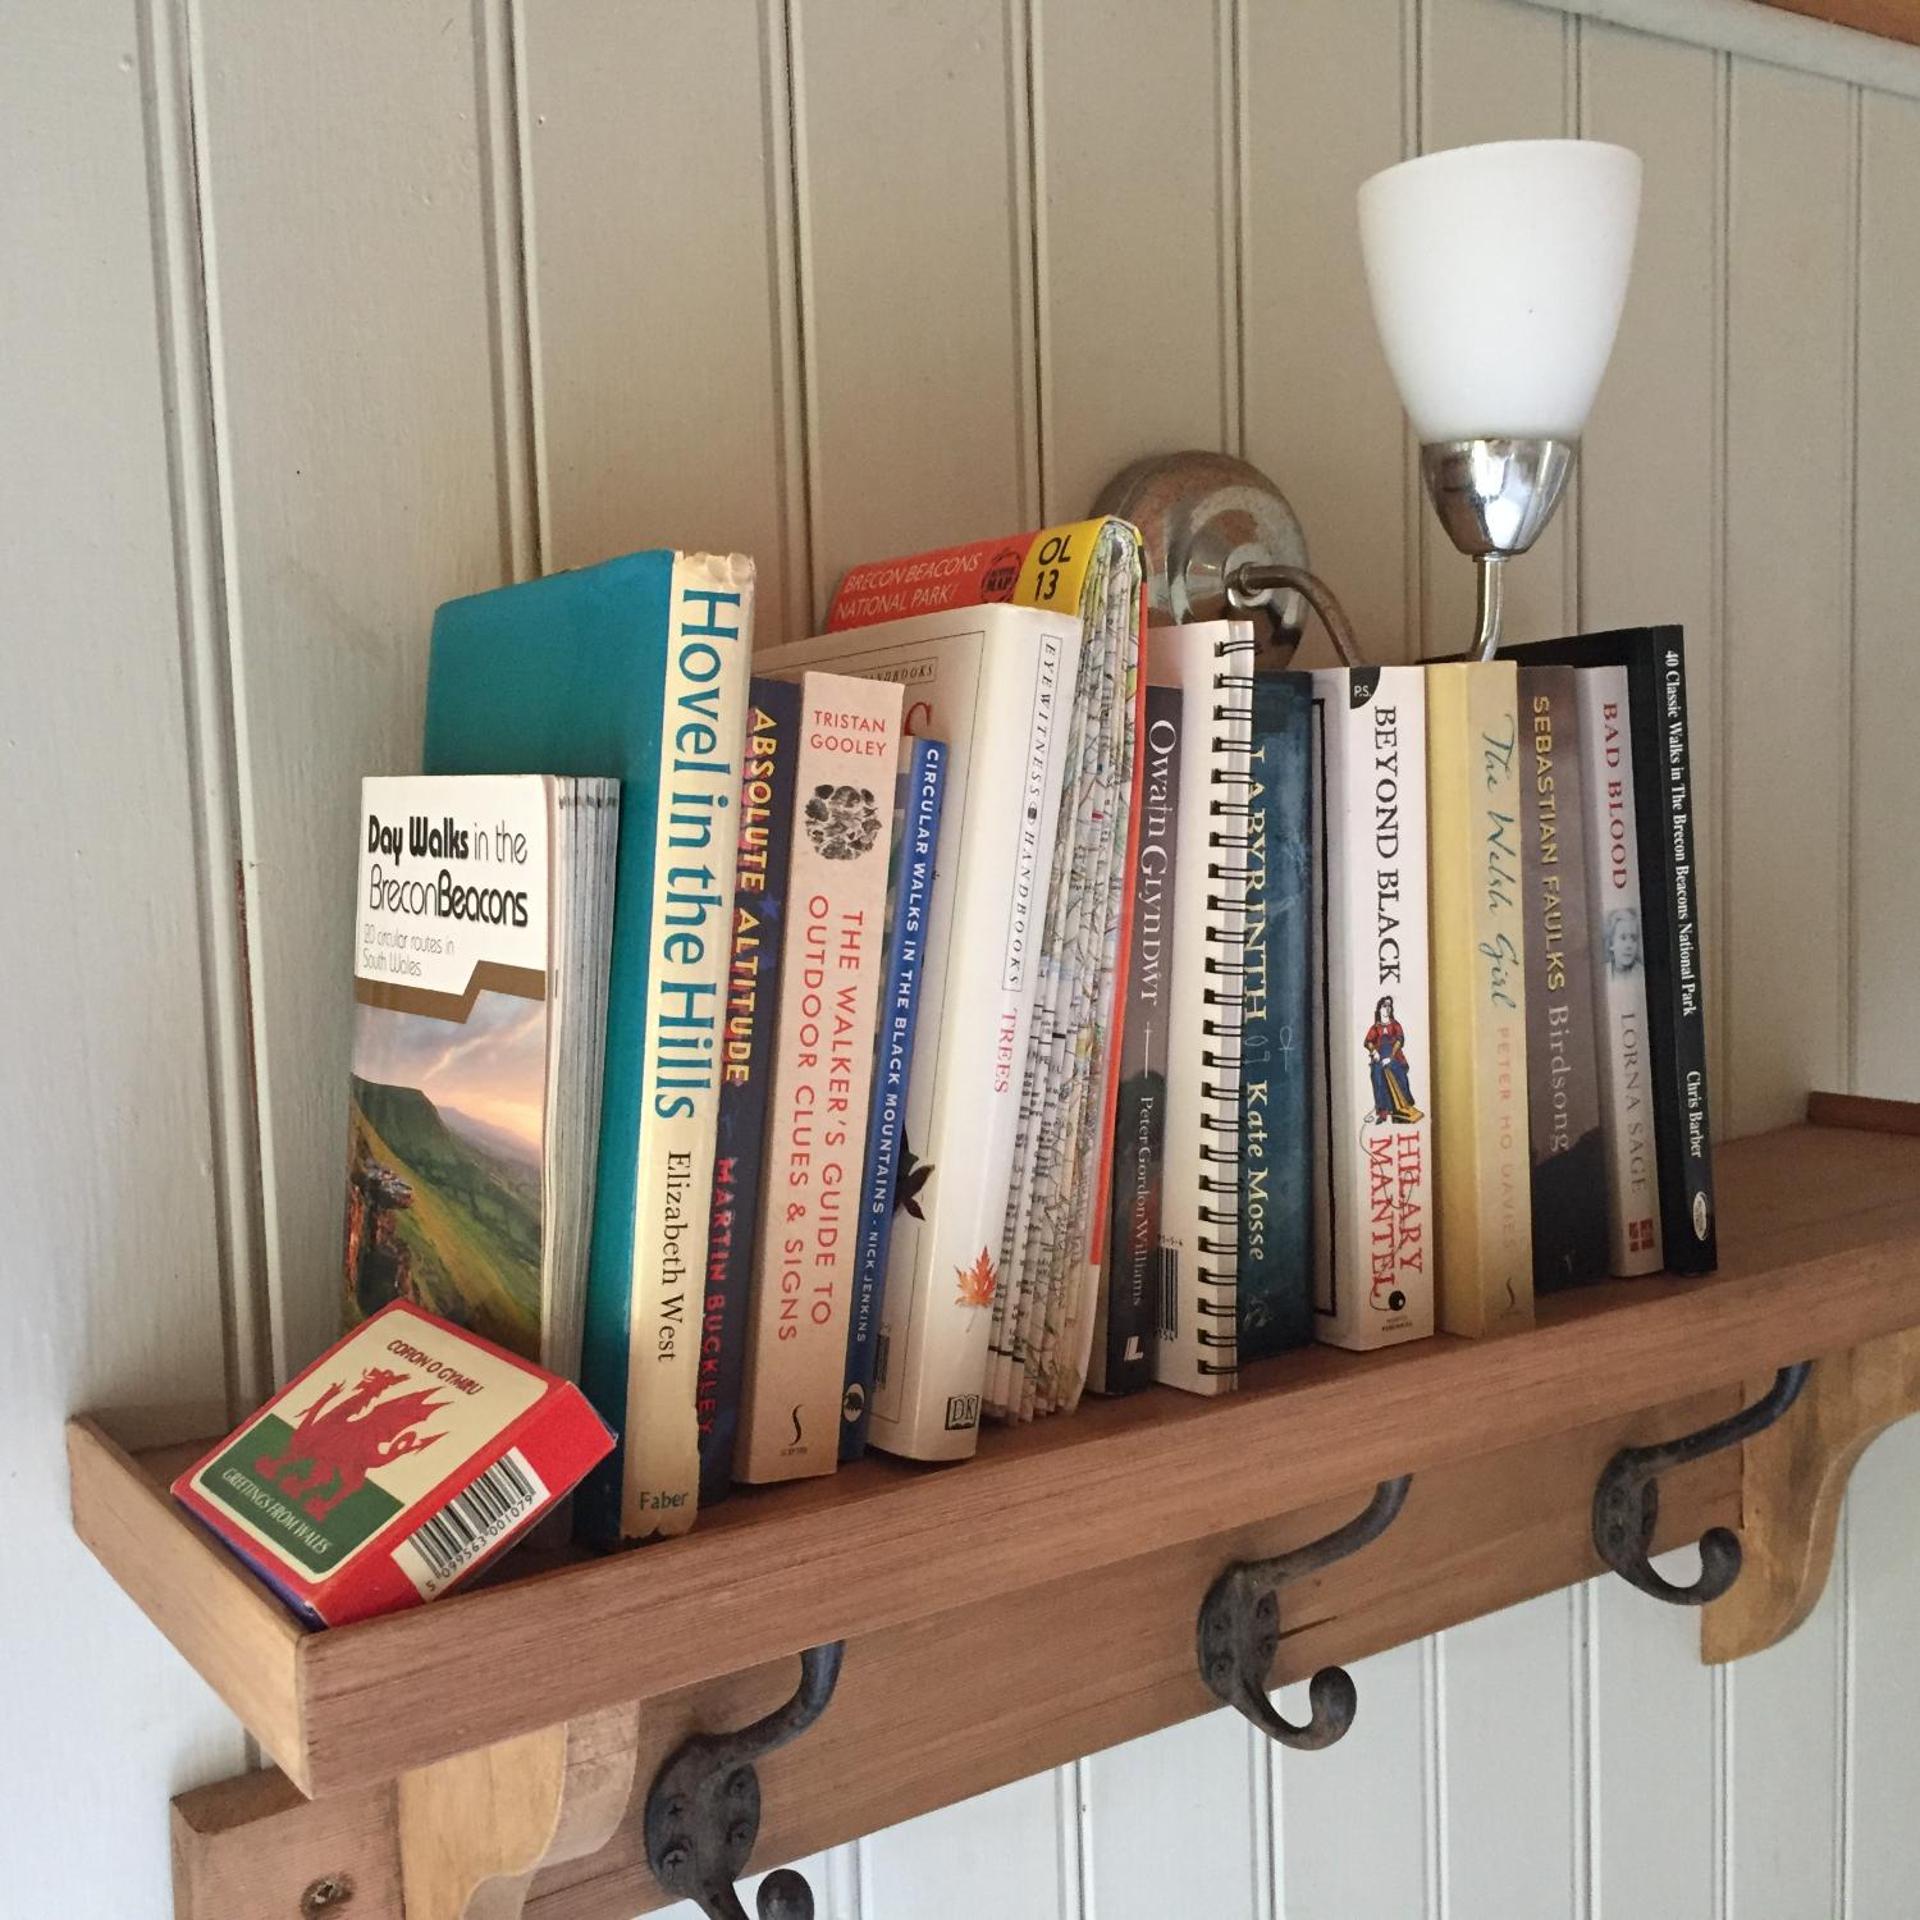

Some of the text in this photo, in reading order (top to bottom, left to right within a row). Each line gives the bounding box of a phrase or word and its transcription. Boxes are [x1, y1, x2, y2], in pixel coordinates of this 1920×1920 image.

[844, 568, 905, 593] BRECON
[905, 552, 982, 582] BEACONS
[1034, 569, 1058, 599] 13
[1039, 534, 1071, 565] OL
[838, 584, 952, 619] NATIONAL PARK
[810, 734, 887, 756] GOOLEY
[813, 710, 886, 733] TRISTAN
[916, 749, 939, 853] CIRCULAR
[1010, 643, 1056, 985] EYEWITNESS HANDBOOKS
[1148, 719, 1176, 837] Owain
[1603, 702, 1627, 890] BAD BLOOD
[368, 815, 527, 866] Day Walks in the
[654, 589, 741, 1119] Hovel in the Hills
[1375, 706, 1400, 985] BEYOND BLACK
[1478, 713, 1519, 1008] The Welsh Girl
[1533, 696, 1565, 992] SEBASTIAN FAULKS
[1665, 650, 1696, 1016] 40 Classic Walks in The Brecon Beacons National Park
[726, 708, 777, 1083] ABSOLUTE ALTITUDE
[906, 863, 926, 931] WALKS
[363, 948, 422, 976] South Wales
[411, 934, 442, 954] routes
[446, 935, 454, 955] in
[898, 970, 912, 1008] THE
[904, 940, 916, 960] IN
[890, 1017, 907, 1084] BLACK
[994, 1008, 1018, 1094] TREES
[1549, 1005, 1571, 1151] Birdsong
[778, 895, 829, 1340] OUTDOOR CLUES & SIGNS
[811, 910, 863, 1325] THE WALKER'S GUIDE TO
[1499, 1116, 1512, 1150] HO
[1621, 1013, 1646, 1194] LORNA SAGE
[1686, 1070, 1703, 1158] Chris Barber
[873, 1093, 898, 1213] MOUNTAINS
[1248, 1080, 1268, 1260] Kate Mosse
[1370, 1135, 1394, 1298] MANTEL
[1397, 1131, 1423, 1273] HILARY
[657, 1150, 692, 1363] Elizabeth West
[699, 1157, 737, 1434] MARTIN BUCKLEY
[866, 1231, 878, 1270] NICK
[857, 1274, 872, 1343] JENKINS
[952, 1399, 974, 1421] DK
[222, 1467, 333, 1555] GREETINGS FROM WALES
[425, 1580, 436, 1592] 5
[489, 1494, 533, 1537] 001079
[639, 1490, 689, 1511] Faber
